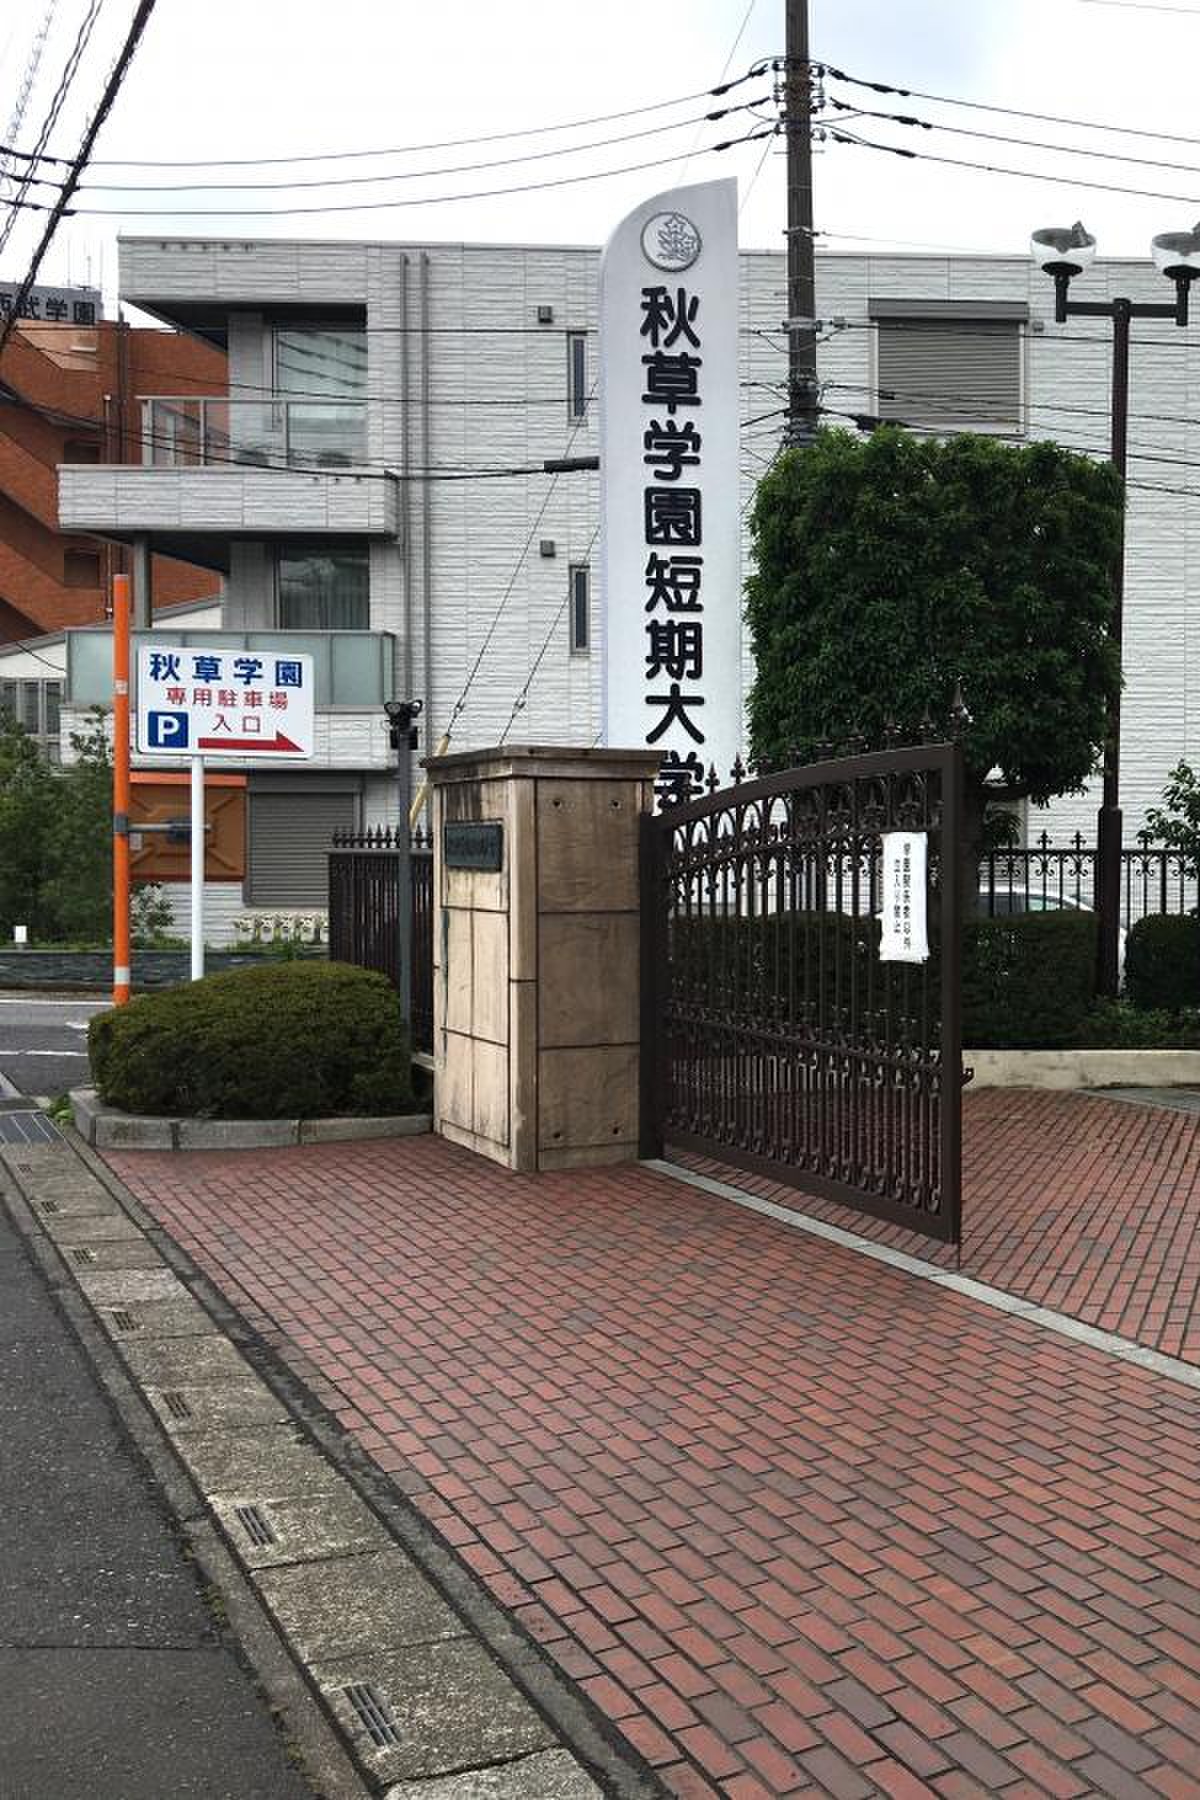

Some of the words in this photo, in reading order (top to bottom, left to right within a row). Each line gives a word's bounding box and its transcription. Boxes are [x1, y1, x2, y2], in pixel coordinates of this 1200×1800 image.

[640, 286, 705, 809] 秋草学園短期大学
[150, 653, 303, 688] 秋草学園
[166, 687, 289, 711] 専用駐車場
[157, 715, 180, 744] P
[212, 713, 261, 733] 入口
